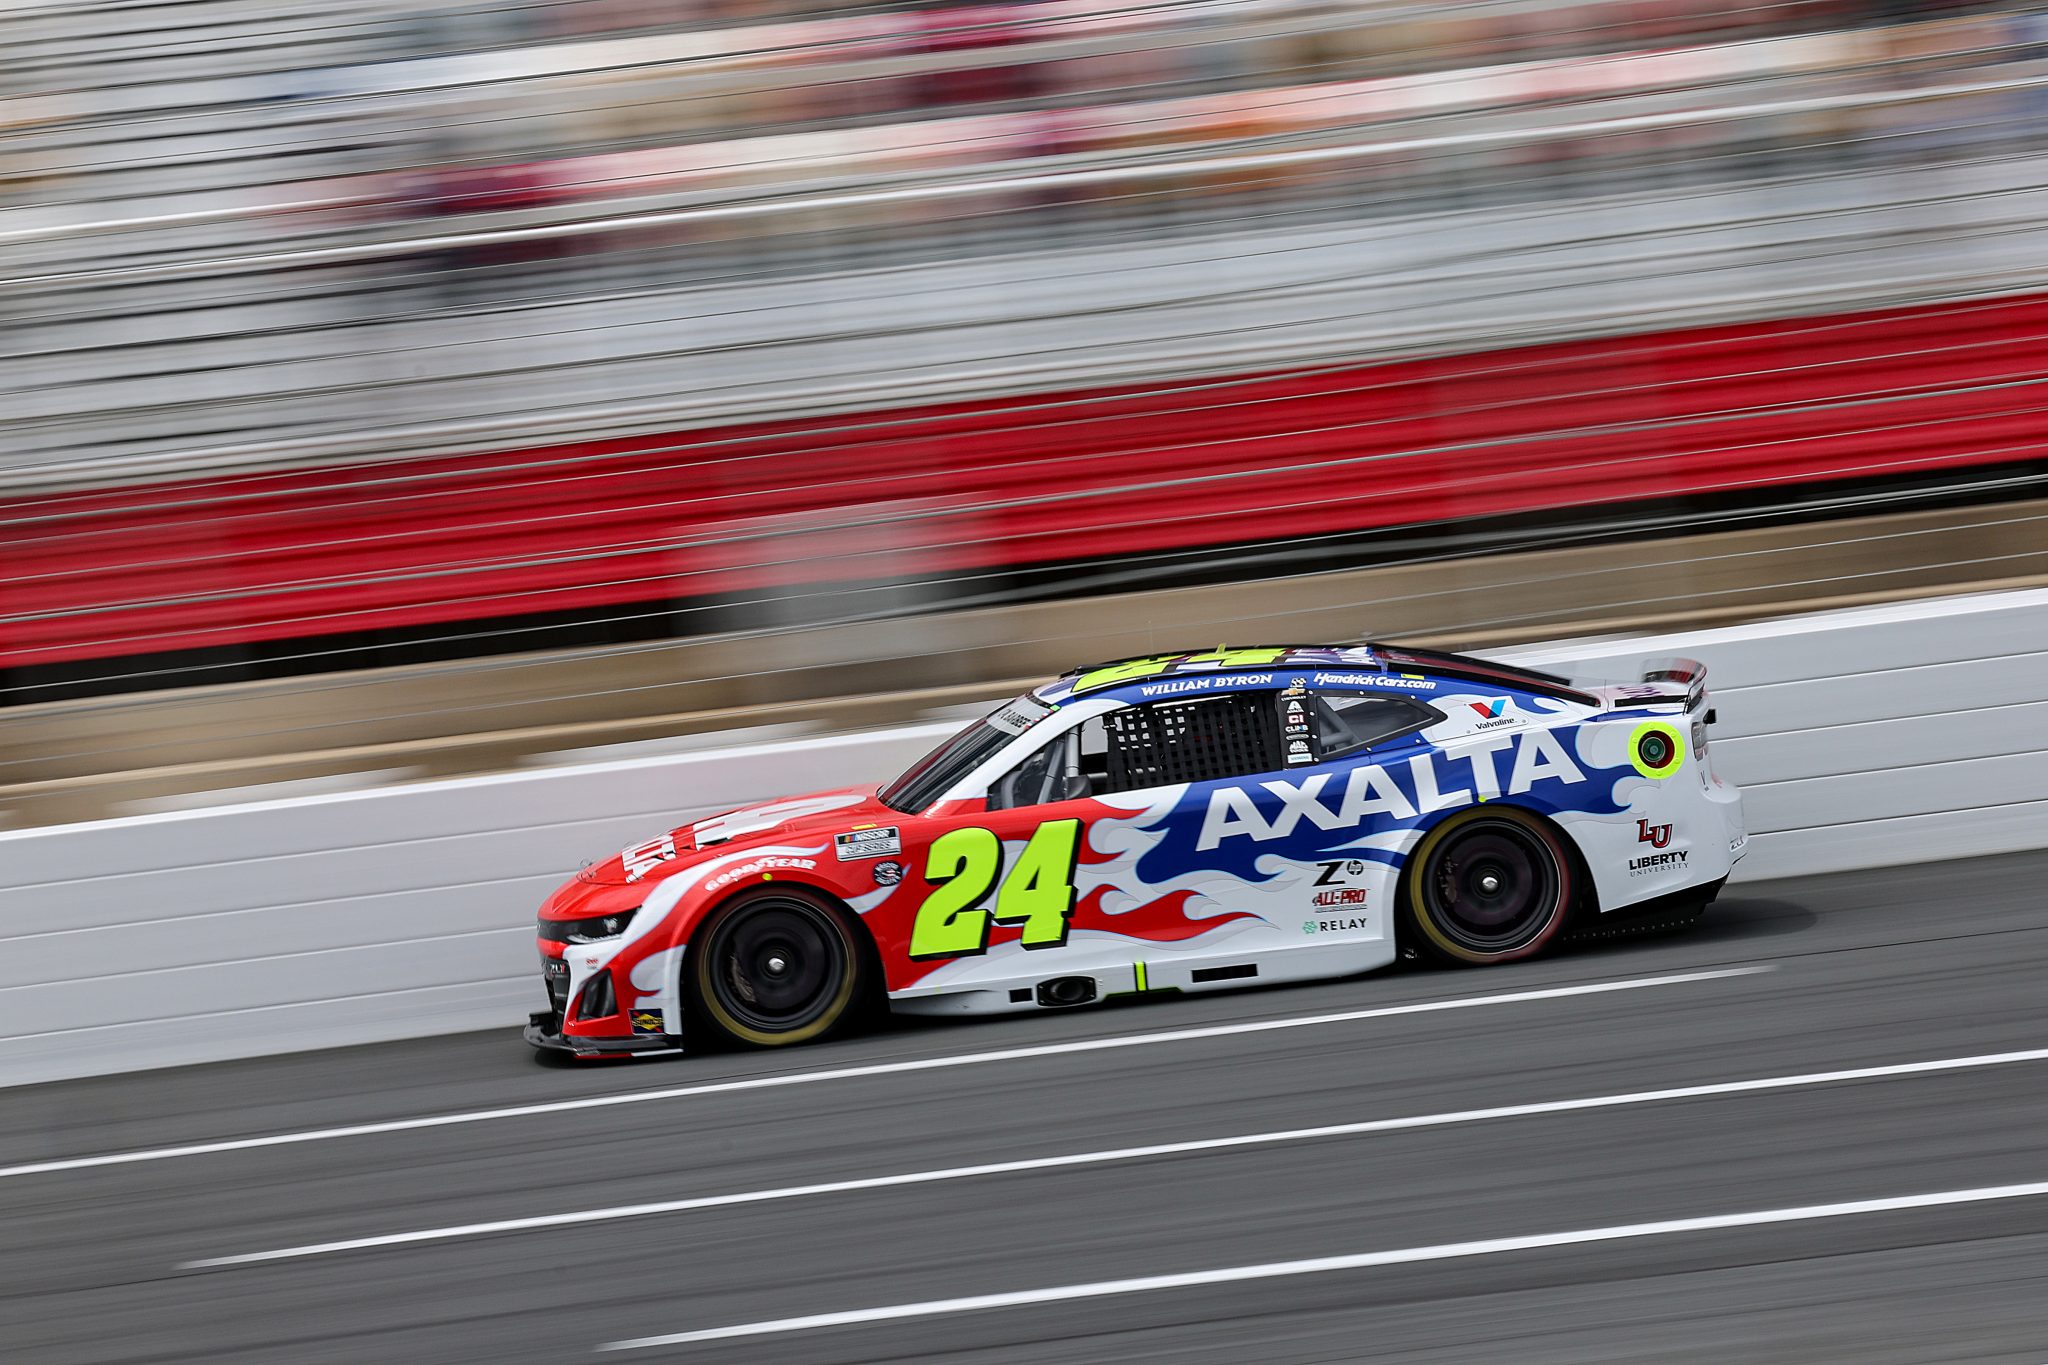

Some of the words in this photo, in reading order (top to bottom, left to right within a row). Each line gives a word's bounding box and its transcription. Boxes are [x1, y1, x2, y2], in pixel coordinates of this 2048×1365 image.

[1141, 679, 1210, 696] WILLIAM
[1214, 674, 1273, 688] BYRON
[1475, 717, 1515, 730] Valvoline
[1196, 729, 1587, 851] AXALTA
[1636, 819, 1673, 849] LU
[1629, 851, 1688, 870] LIBERTY
[1629, 862, 1689, 878] UNIVERSITY
[704, 856, 817, 891] GOODYEAR
[1312, 861, 1345, 887] Z
[909, 818, 1083, 960] 24
[1320, 918, 1367, 932] RELAY
